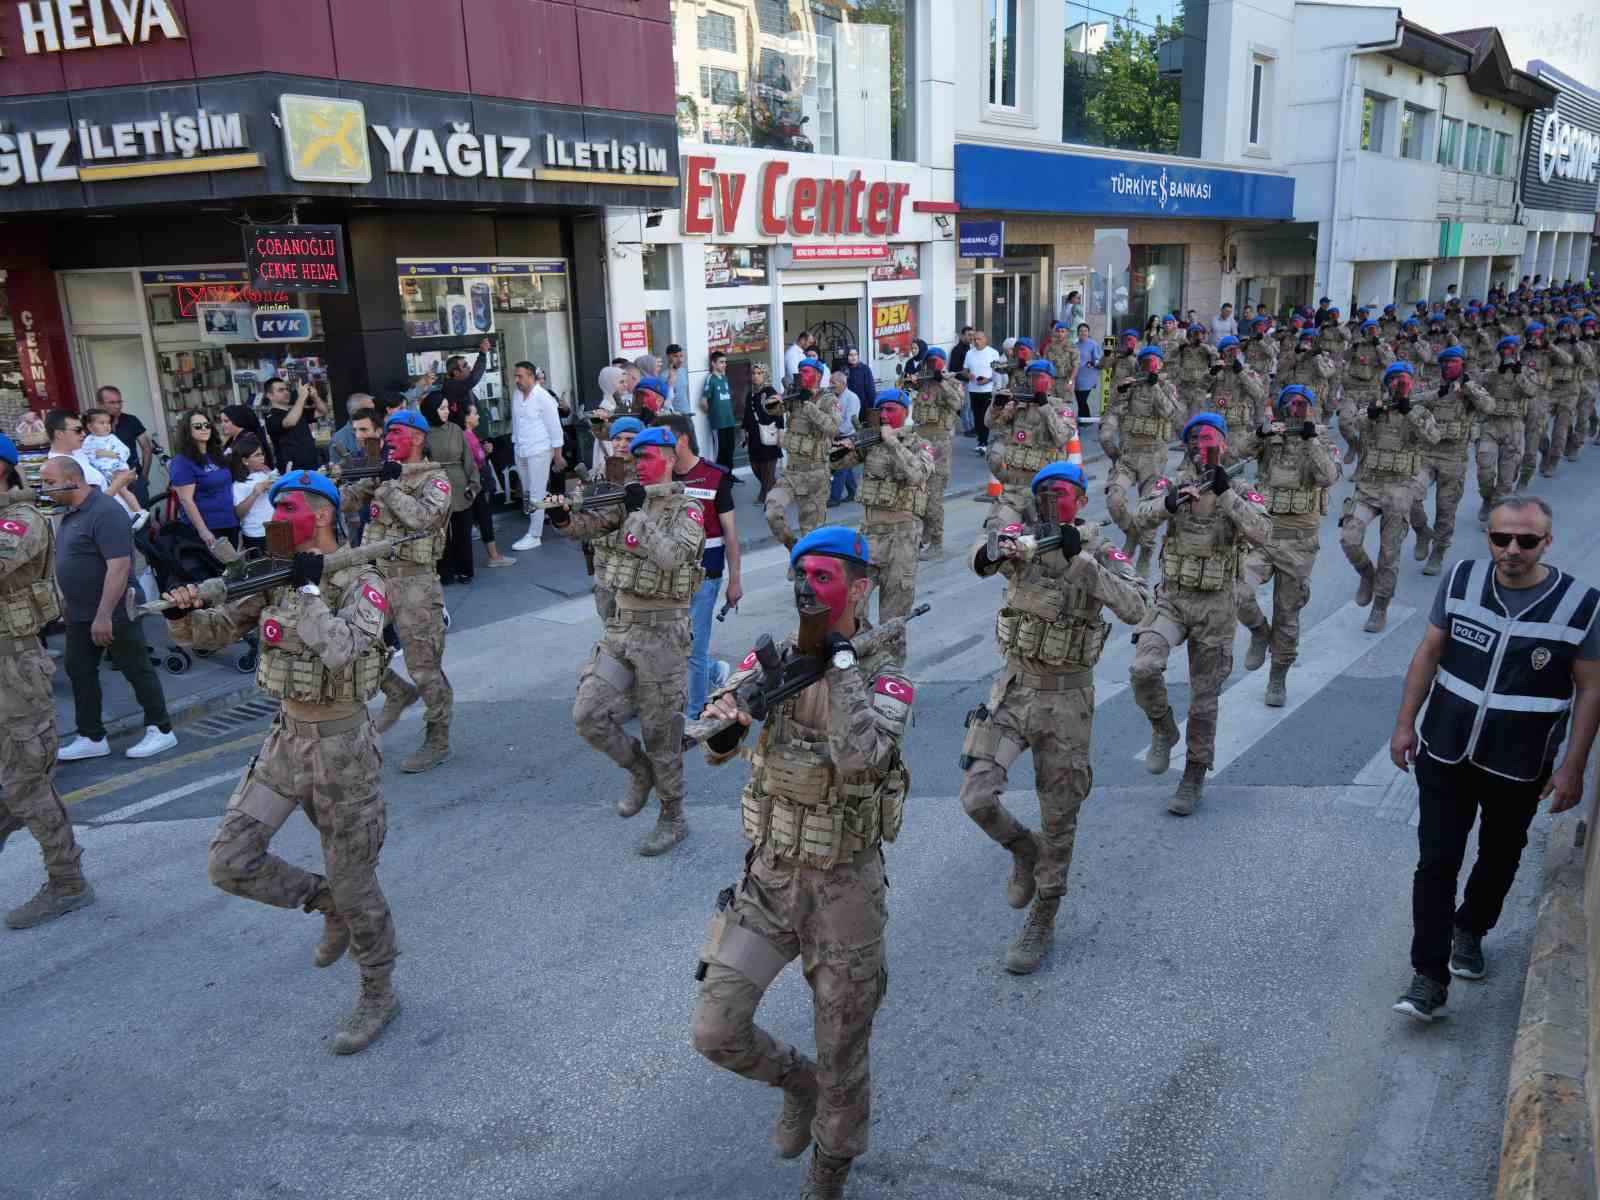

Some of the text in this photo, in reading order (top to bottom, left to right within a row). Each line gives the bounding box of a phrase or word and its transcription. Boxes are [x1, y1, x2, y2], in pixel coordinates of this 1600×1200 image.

[17, 0, 183, 54] HELVA
[78, 109, 243, 158] İLETİŞİM
[371, 121, 668, 179] YAĞIZ İLETİŞİM
[684, 155, 911, 236] Ev Center
[1111, 173, 1212, 200] TÜRKİYE BANKASI
[255, 237, 336, 258] ÇOBANOĞLU
[259, 262, 339, 281] ÇEKME HELVA
[262, 319, 301, 332] KVK
[876, 303, 910, 328] DEV
[20, 309, 48, 397] ÇEKME
[1455, 625, 1487, 644] POLİS
